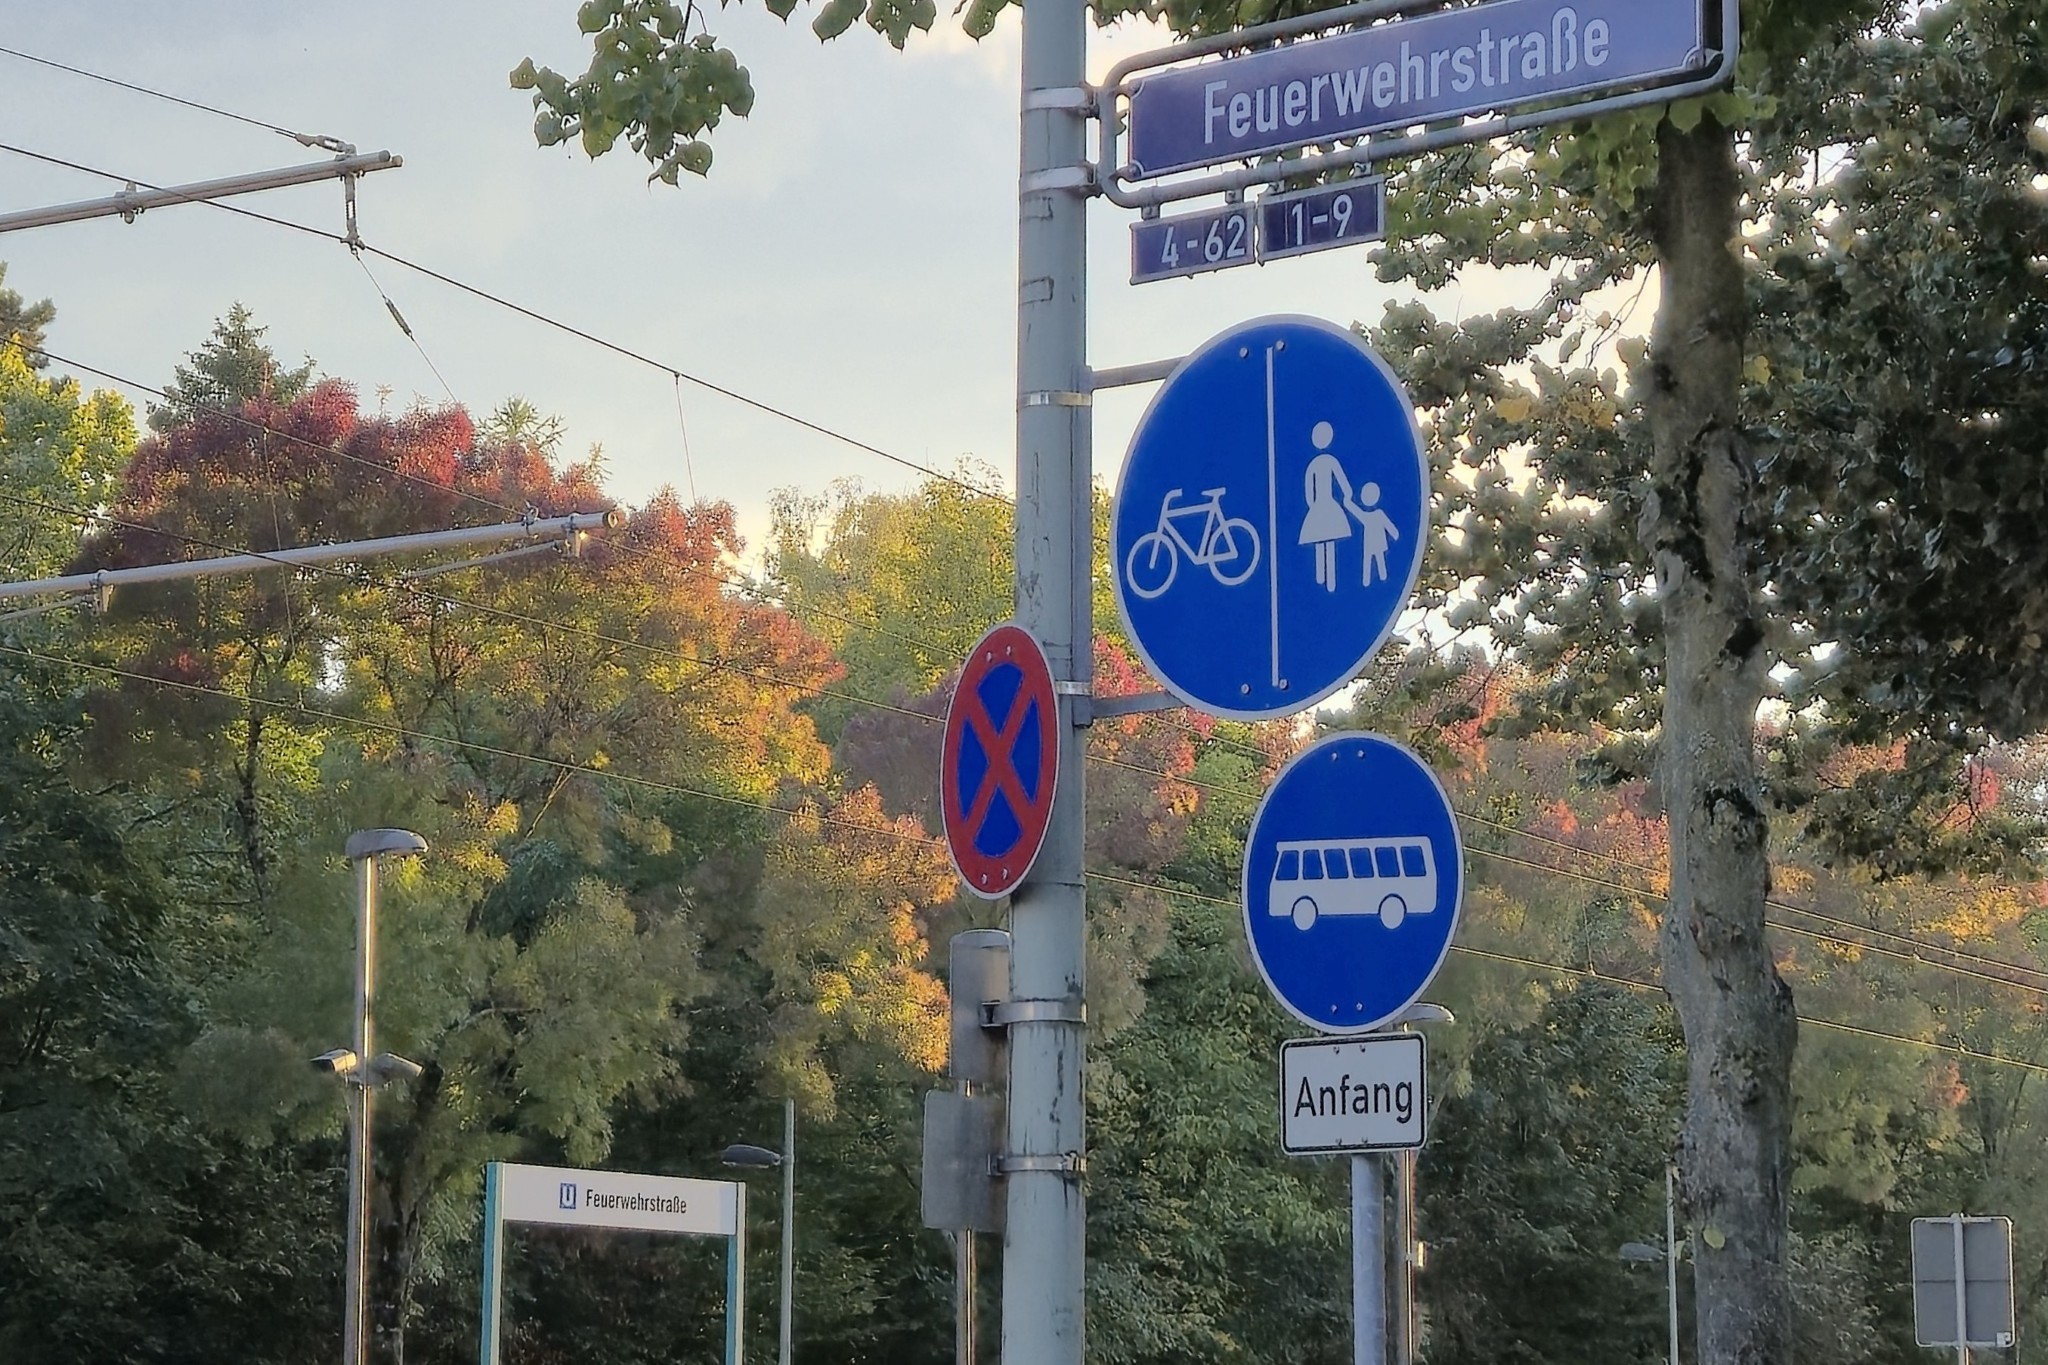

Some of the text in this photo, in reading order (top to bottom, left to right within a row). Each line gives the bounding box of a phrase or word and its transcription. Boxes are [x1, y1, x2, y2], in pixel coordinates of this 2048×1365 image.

[1204, 7, 1611, 144] Feuerwehrstraße
[1161, 215, 1246, 268] 4-62
[1291, 194, 1353, 246] 1-9
[1294, 1074, 1412, 1124] Anfang
[586, 1189, 687, 1214] Feuerwehrstraße
